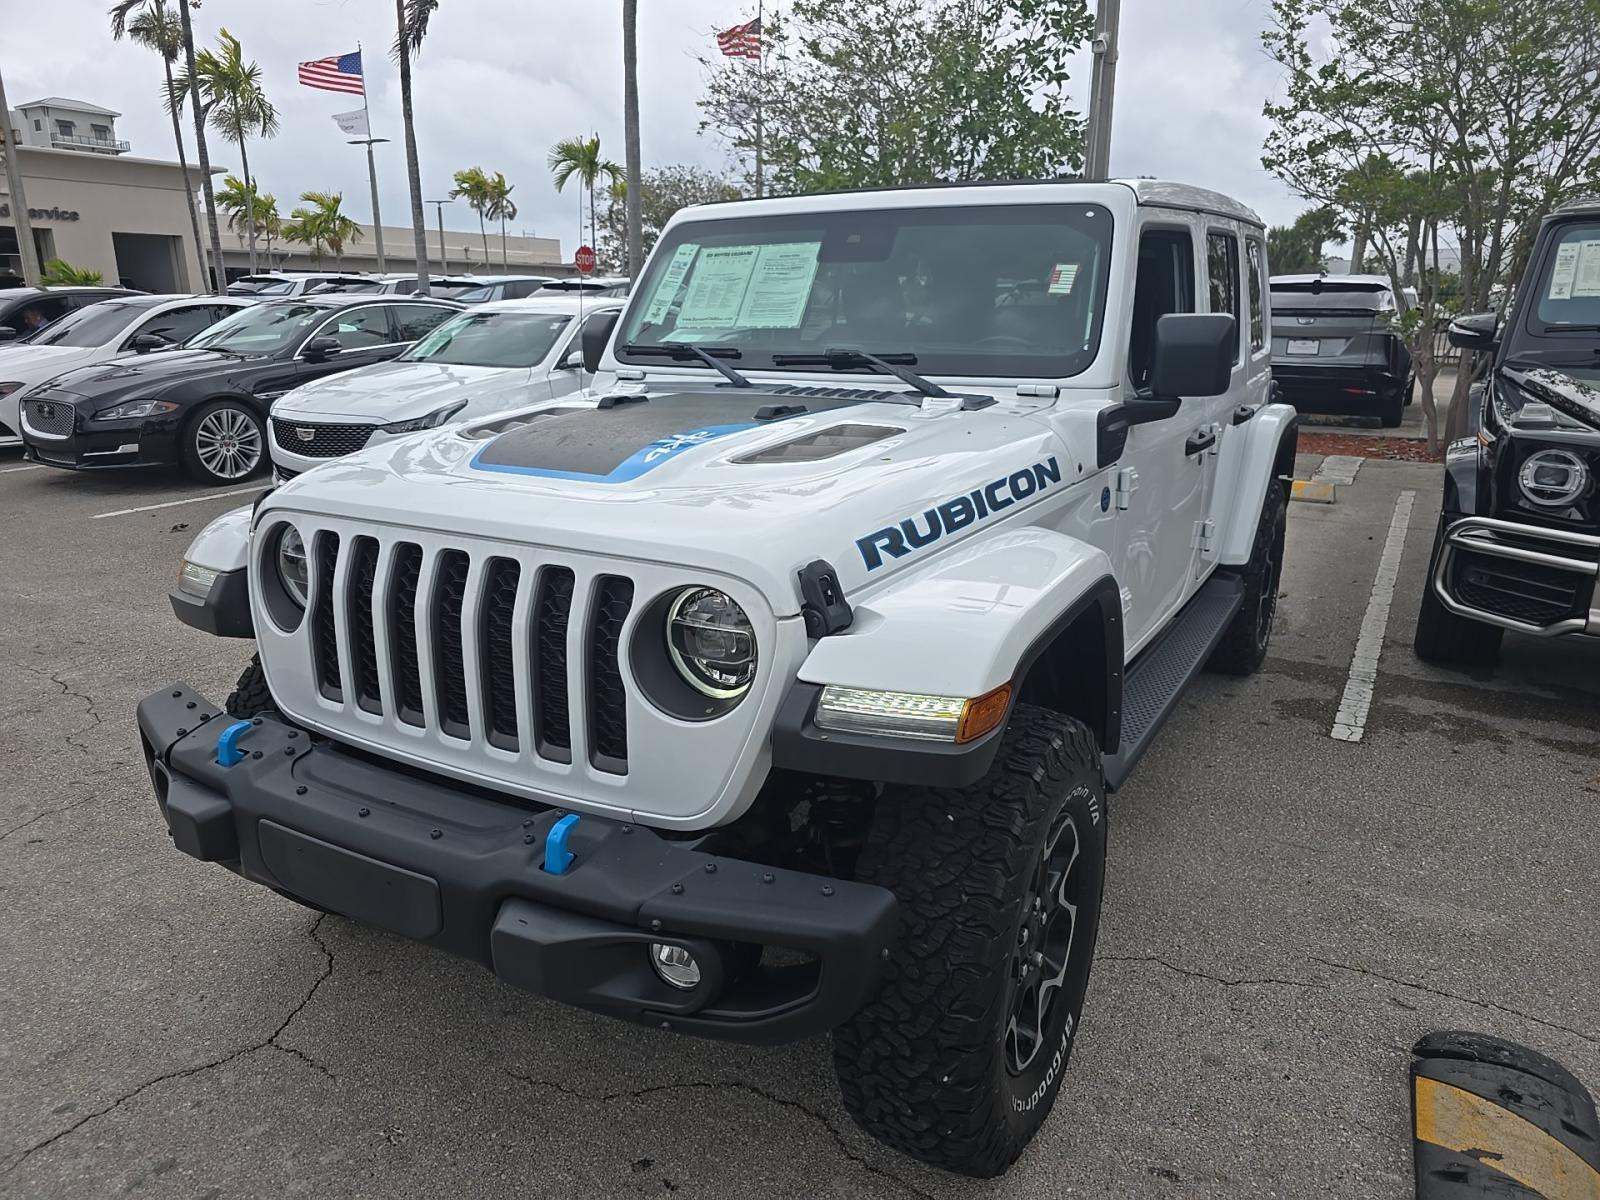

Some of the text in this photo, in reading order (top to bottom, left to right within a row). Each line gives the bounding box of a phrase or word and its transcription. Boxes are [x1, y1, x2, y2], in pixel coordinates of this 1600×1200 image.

[27, 206, 80, 221] ervice
[576, 254, 595, 265] STOP
[854, 455, 1062, 572] RUBICON
[1011, 1012, 1074, 1112] BFGoodrich
